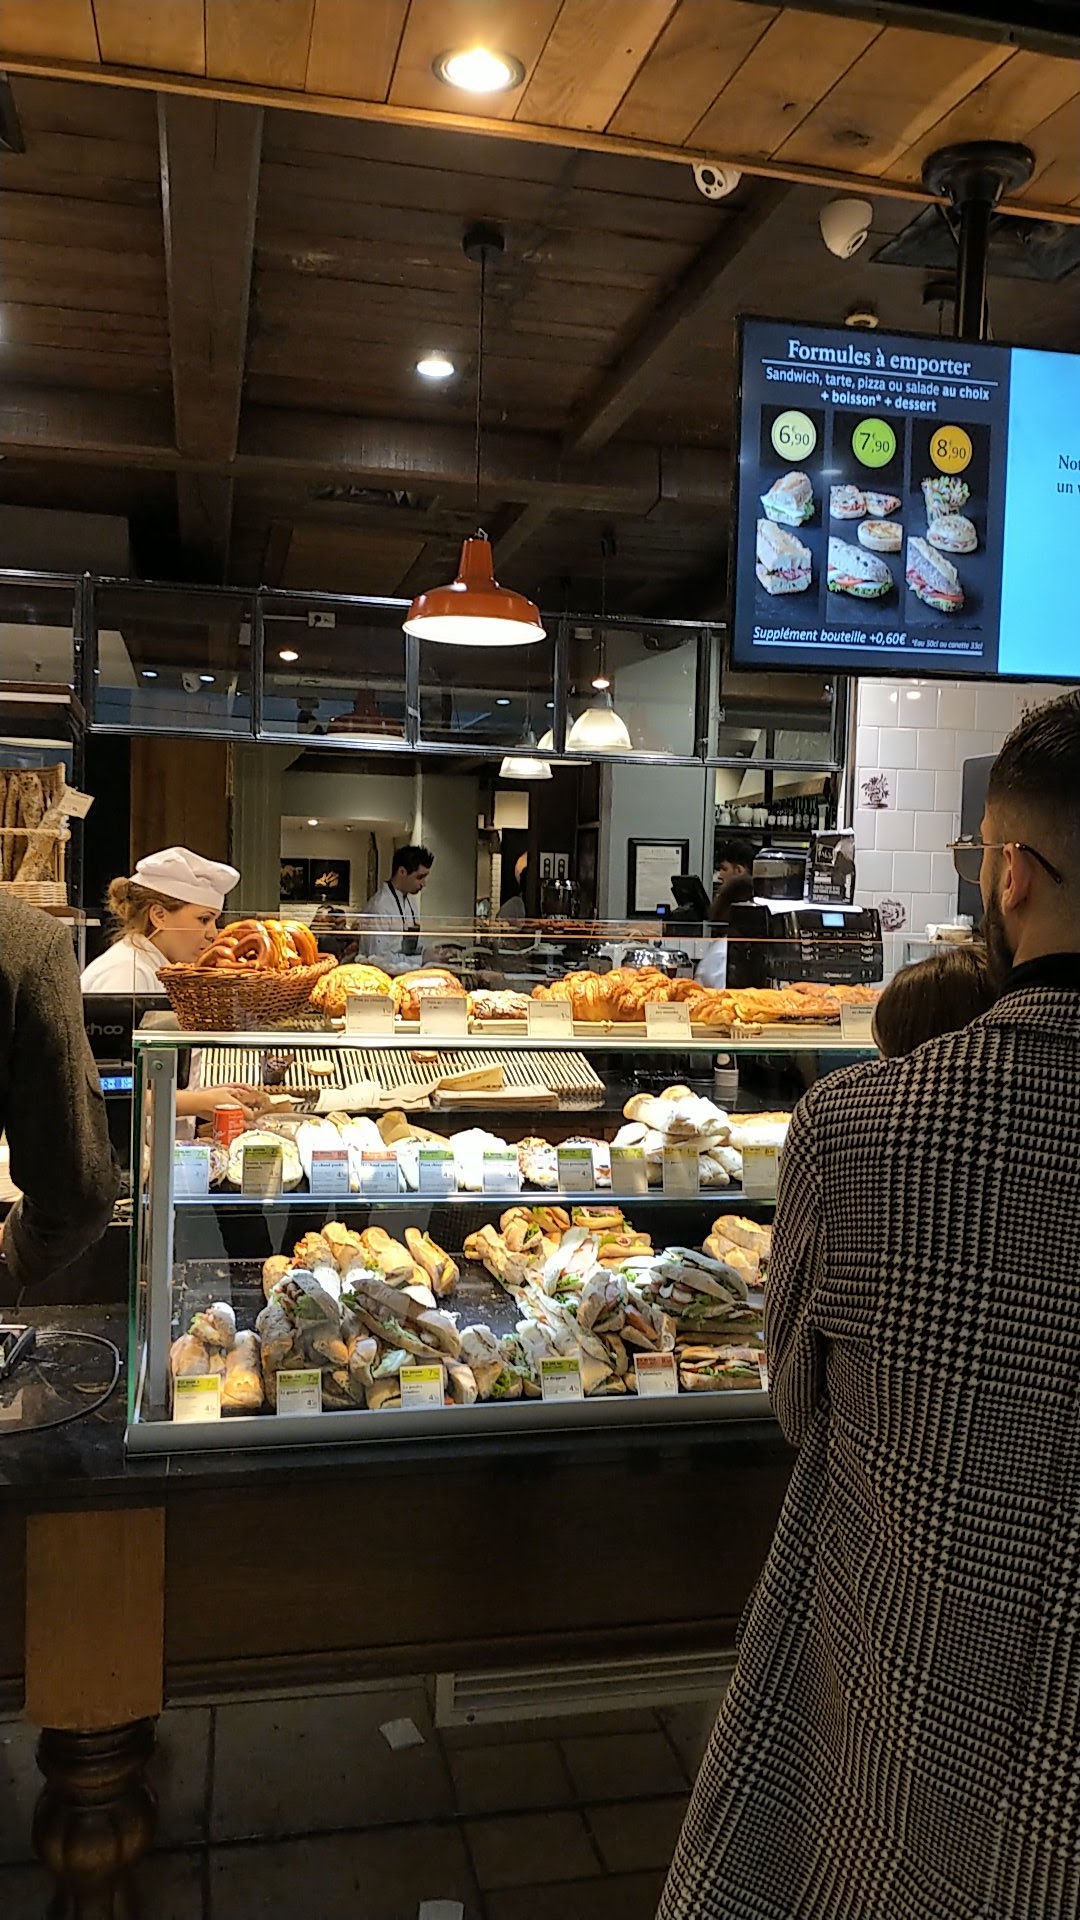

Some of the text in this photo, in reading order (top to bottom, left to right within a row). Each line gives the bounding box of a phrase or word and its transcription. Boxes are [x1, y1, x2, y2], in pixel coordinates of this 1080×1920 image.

[787, 339, 972, 377] Formules à emporter
[765, 366, 990, 401] Sandwich, tarte, pizza ou salade au choix
[895, 396, 937, 413] dessert
[1057, 482, 1073, 494] un
[752, 626, 819, 643] Supplément
[820, 629, 866, 644] bouteille
[869, 631, 907, 647] +0,60€
